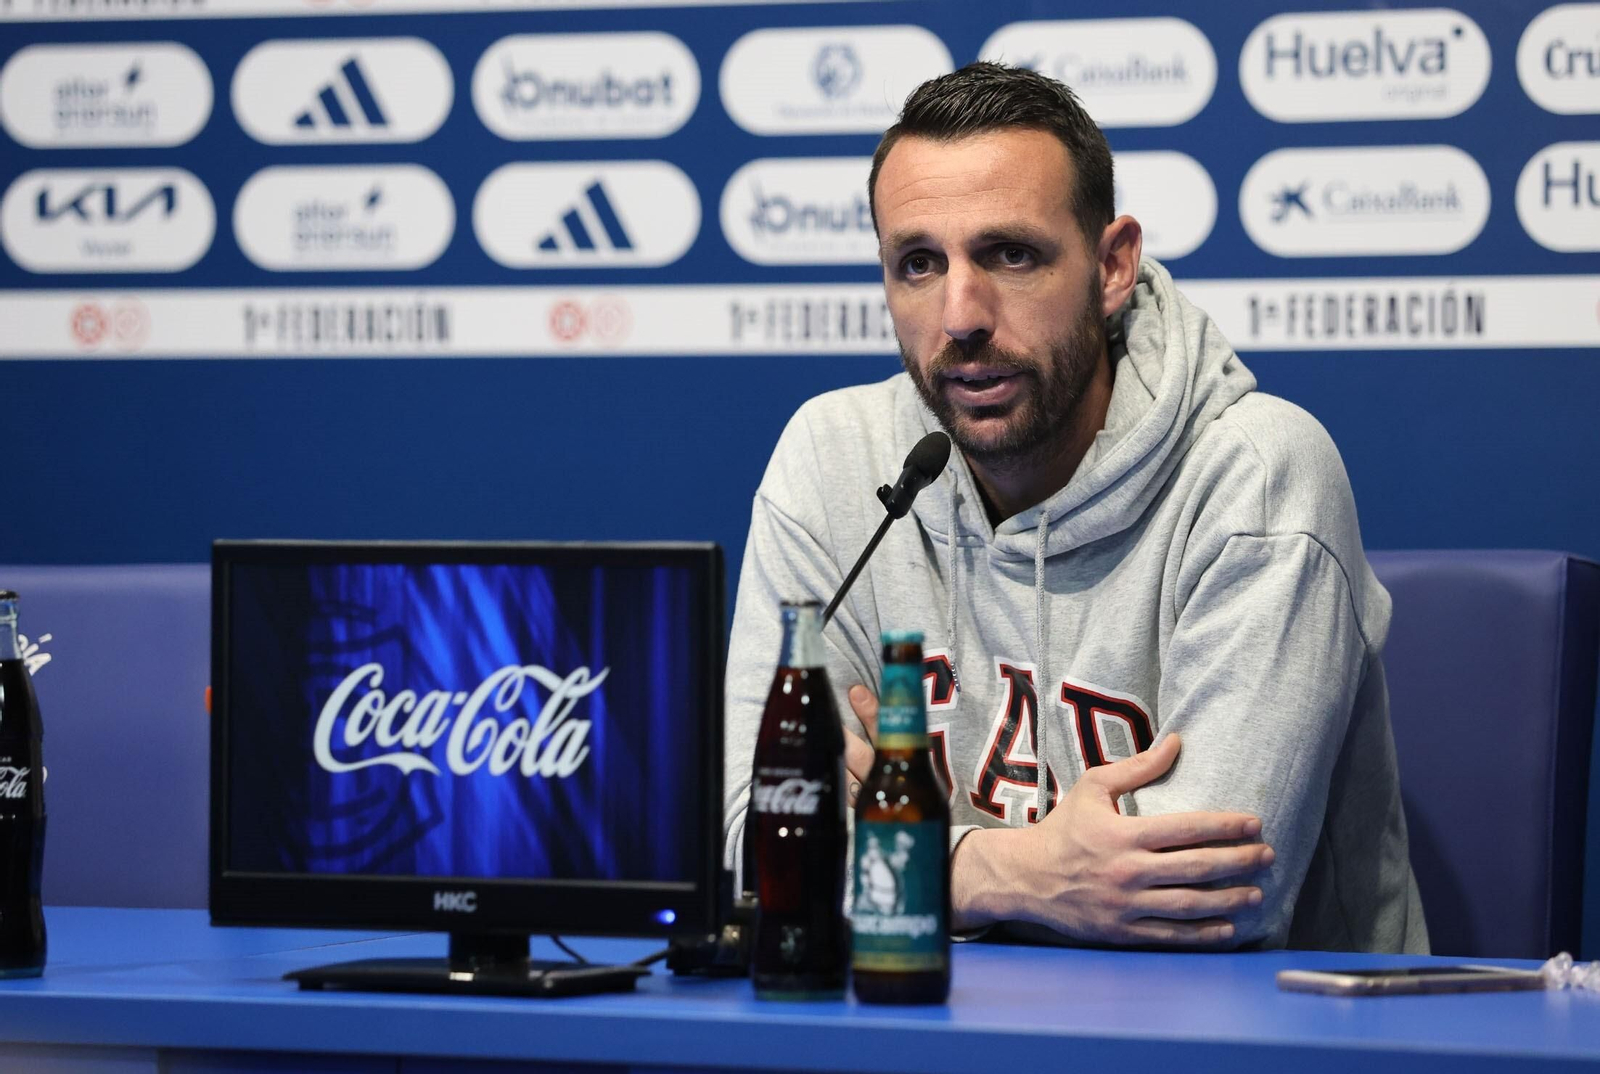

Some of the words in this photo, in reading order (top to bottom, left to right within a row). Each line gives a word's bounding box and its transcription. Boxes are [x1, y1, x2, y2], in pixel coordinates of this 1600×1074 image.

[1263, 26, 1447, 79] Huelva
[313, 662, 610, 778] Coca-Cola
[434, 891, 477, 913] HKC
